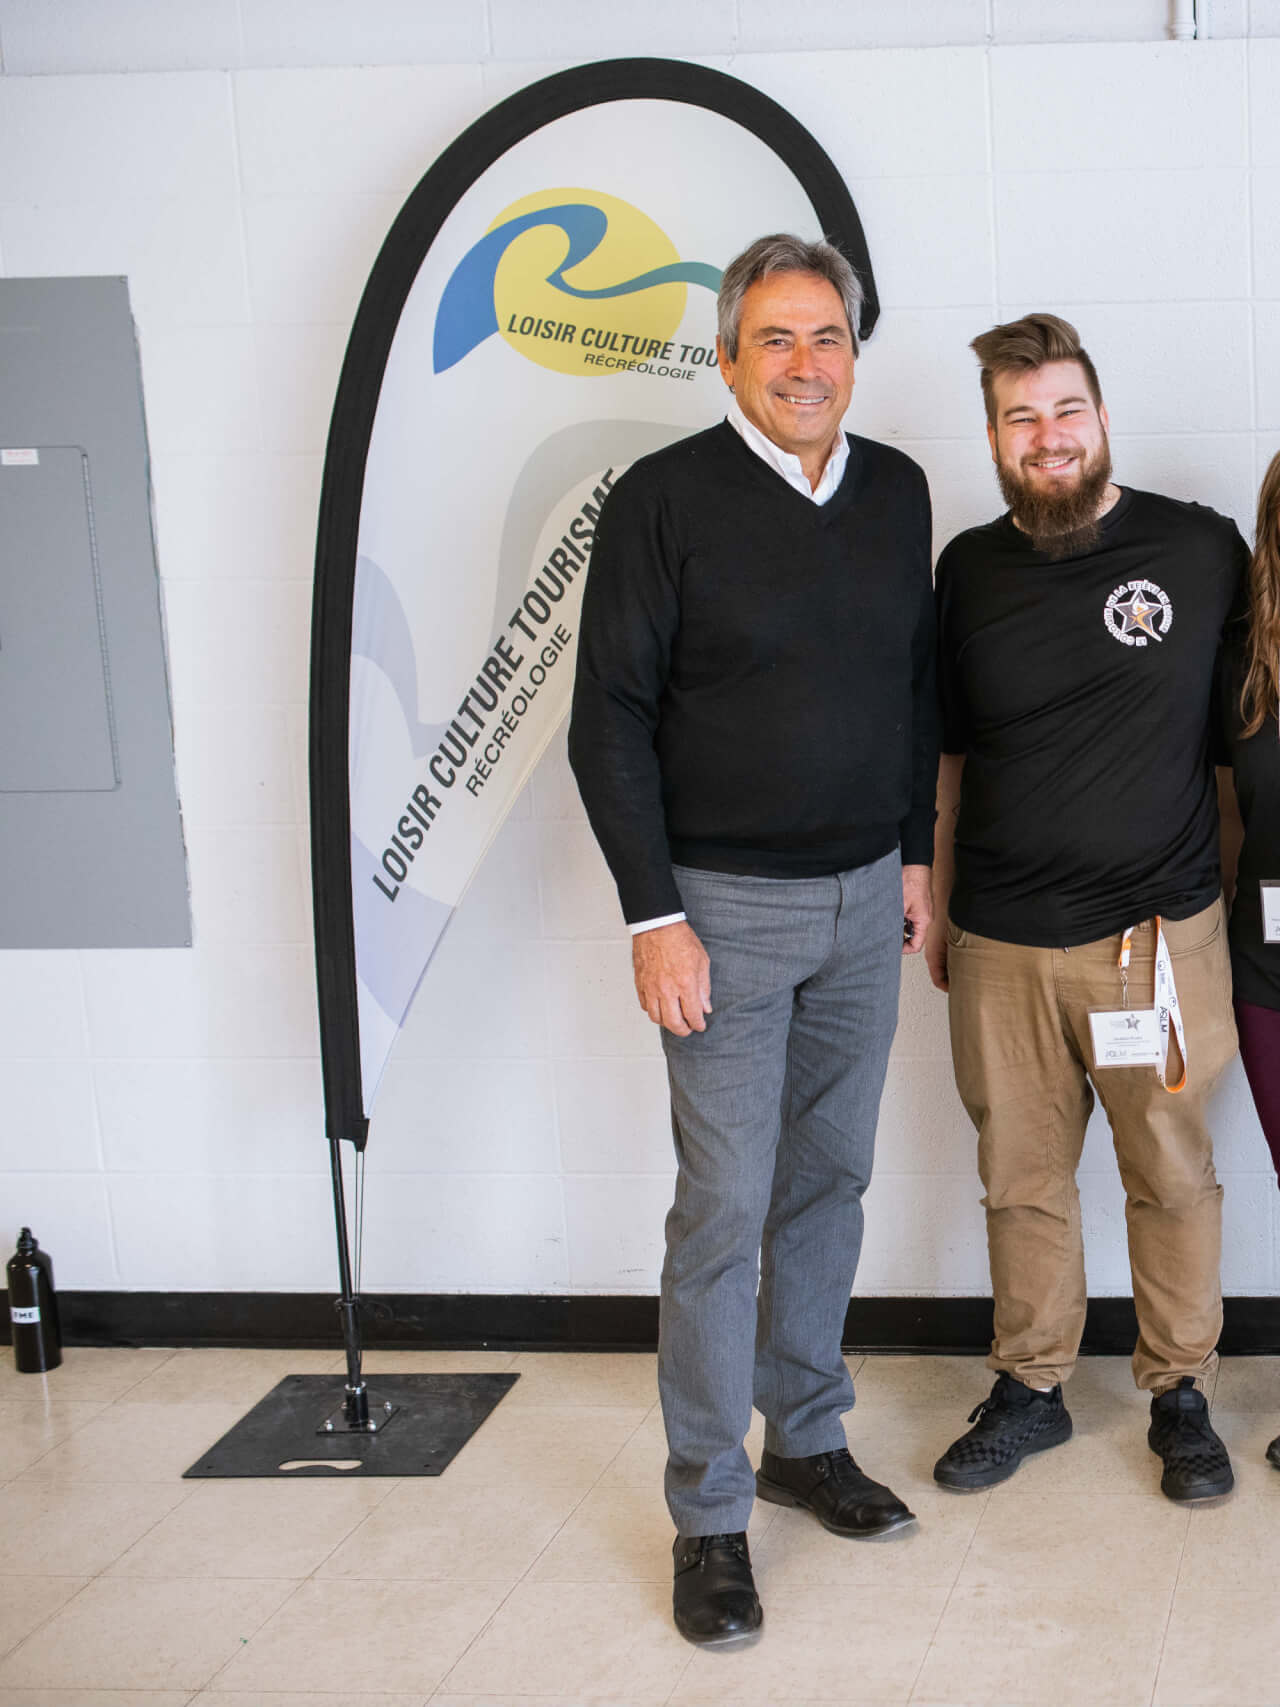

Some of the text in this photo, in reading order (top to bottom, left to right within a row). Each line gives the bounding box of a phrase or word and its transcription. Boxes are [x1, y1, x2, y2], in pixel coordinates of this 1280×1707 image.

[507, 313, 577, 344] LOISIR
[581, 327, 676, 361] CULTURE
[584, 353, 697, 381] RÉCRÉOLOGIE
[466, 623, 572, 797] RÉCRÉOLOGIE
[372, 783, 442, 903] LOISIR
[429, 635, 525, 788] CULTURE
